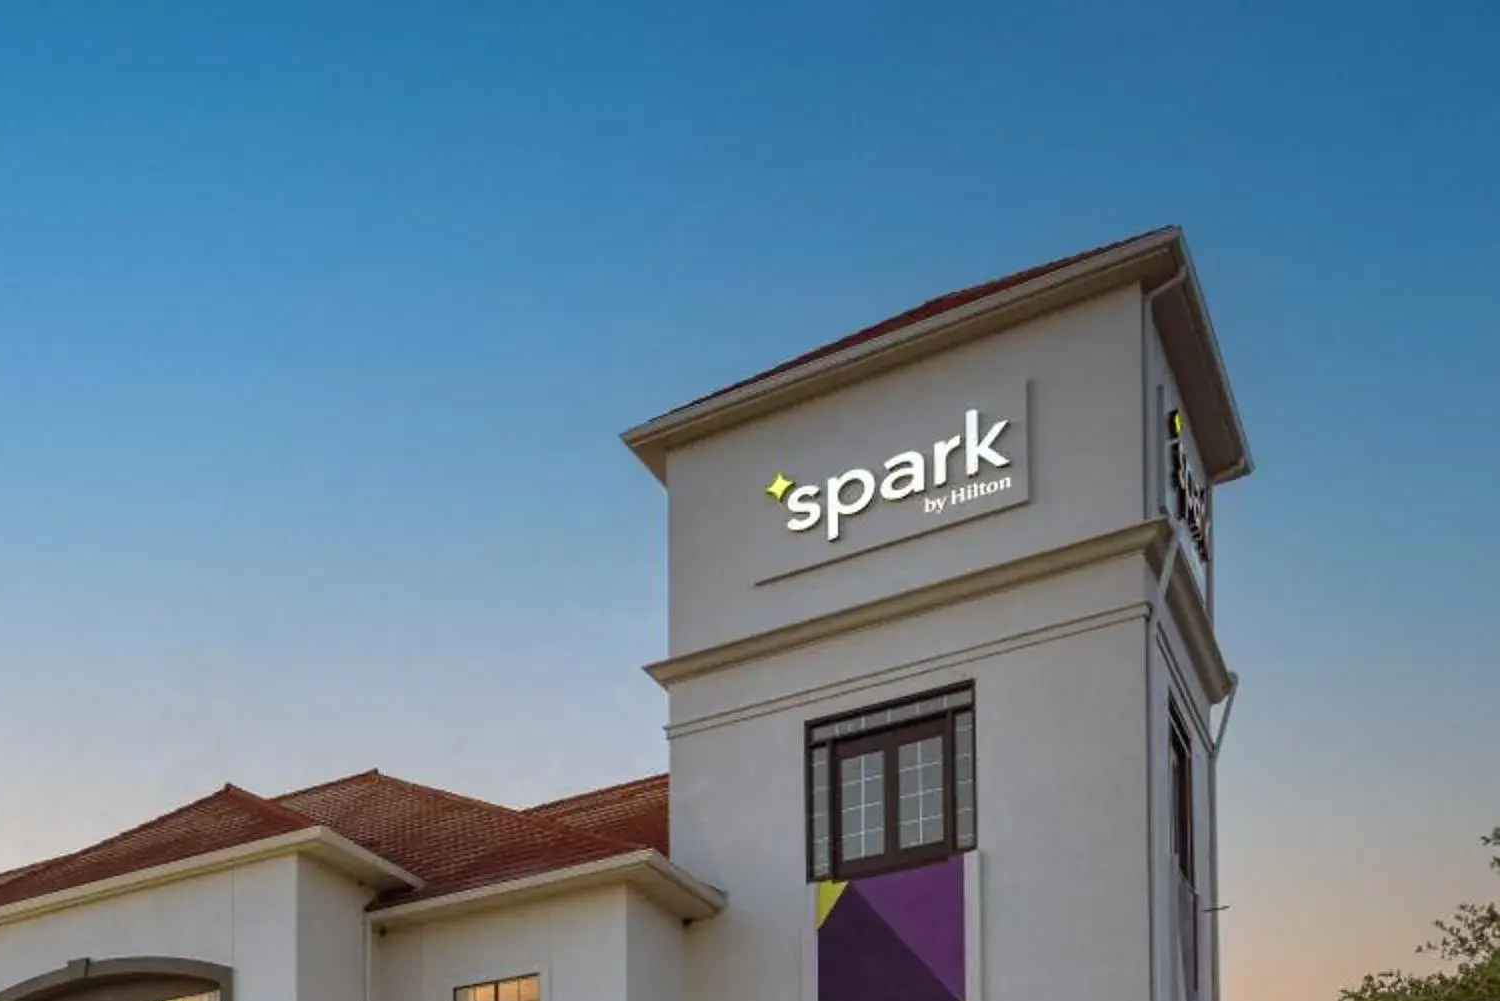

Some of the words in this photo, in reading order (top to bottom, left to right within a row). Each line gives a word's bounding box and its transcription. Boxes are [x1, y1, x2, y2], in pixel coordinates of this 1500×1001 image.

[787, 408, 1011, 541] spark
[924, 497, 946, 514] by
[951, 476, 1012, 505] Hilton
